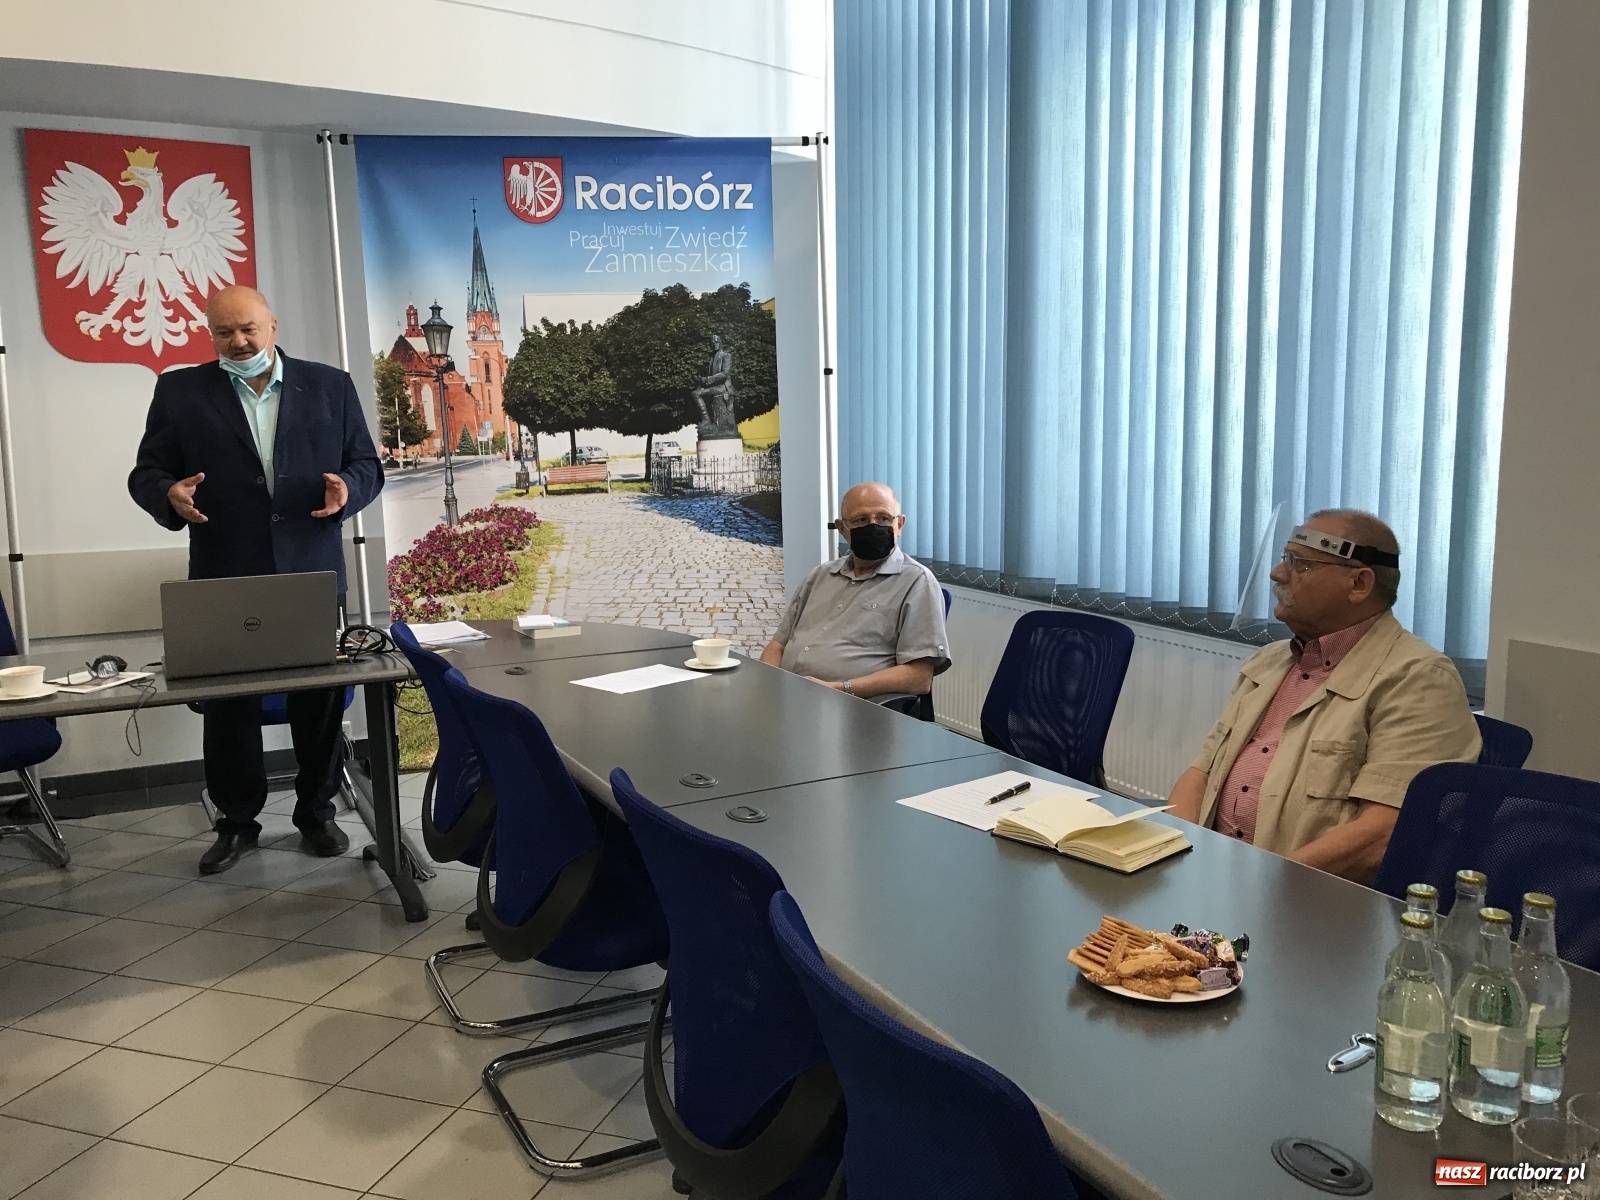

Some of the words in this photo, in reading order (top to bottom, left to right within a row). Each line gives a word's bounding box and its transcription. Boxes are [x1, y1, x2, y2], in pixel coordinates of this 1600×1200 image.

[575, 170, 754, 211] Racibórz
[569, 230, 625, 251] Pracuj
[602, 221, 662, 239] Inwestuj
[665, 225, 748, 248] Zwiedź
[584, 245, 741, 278] Zamieszkaj
